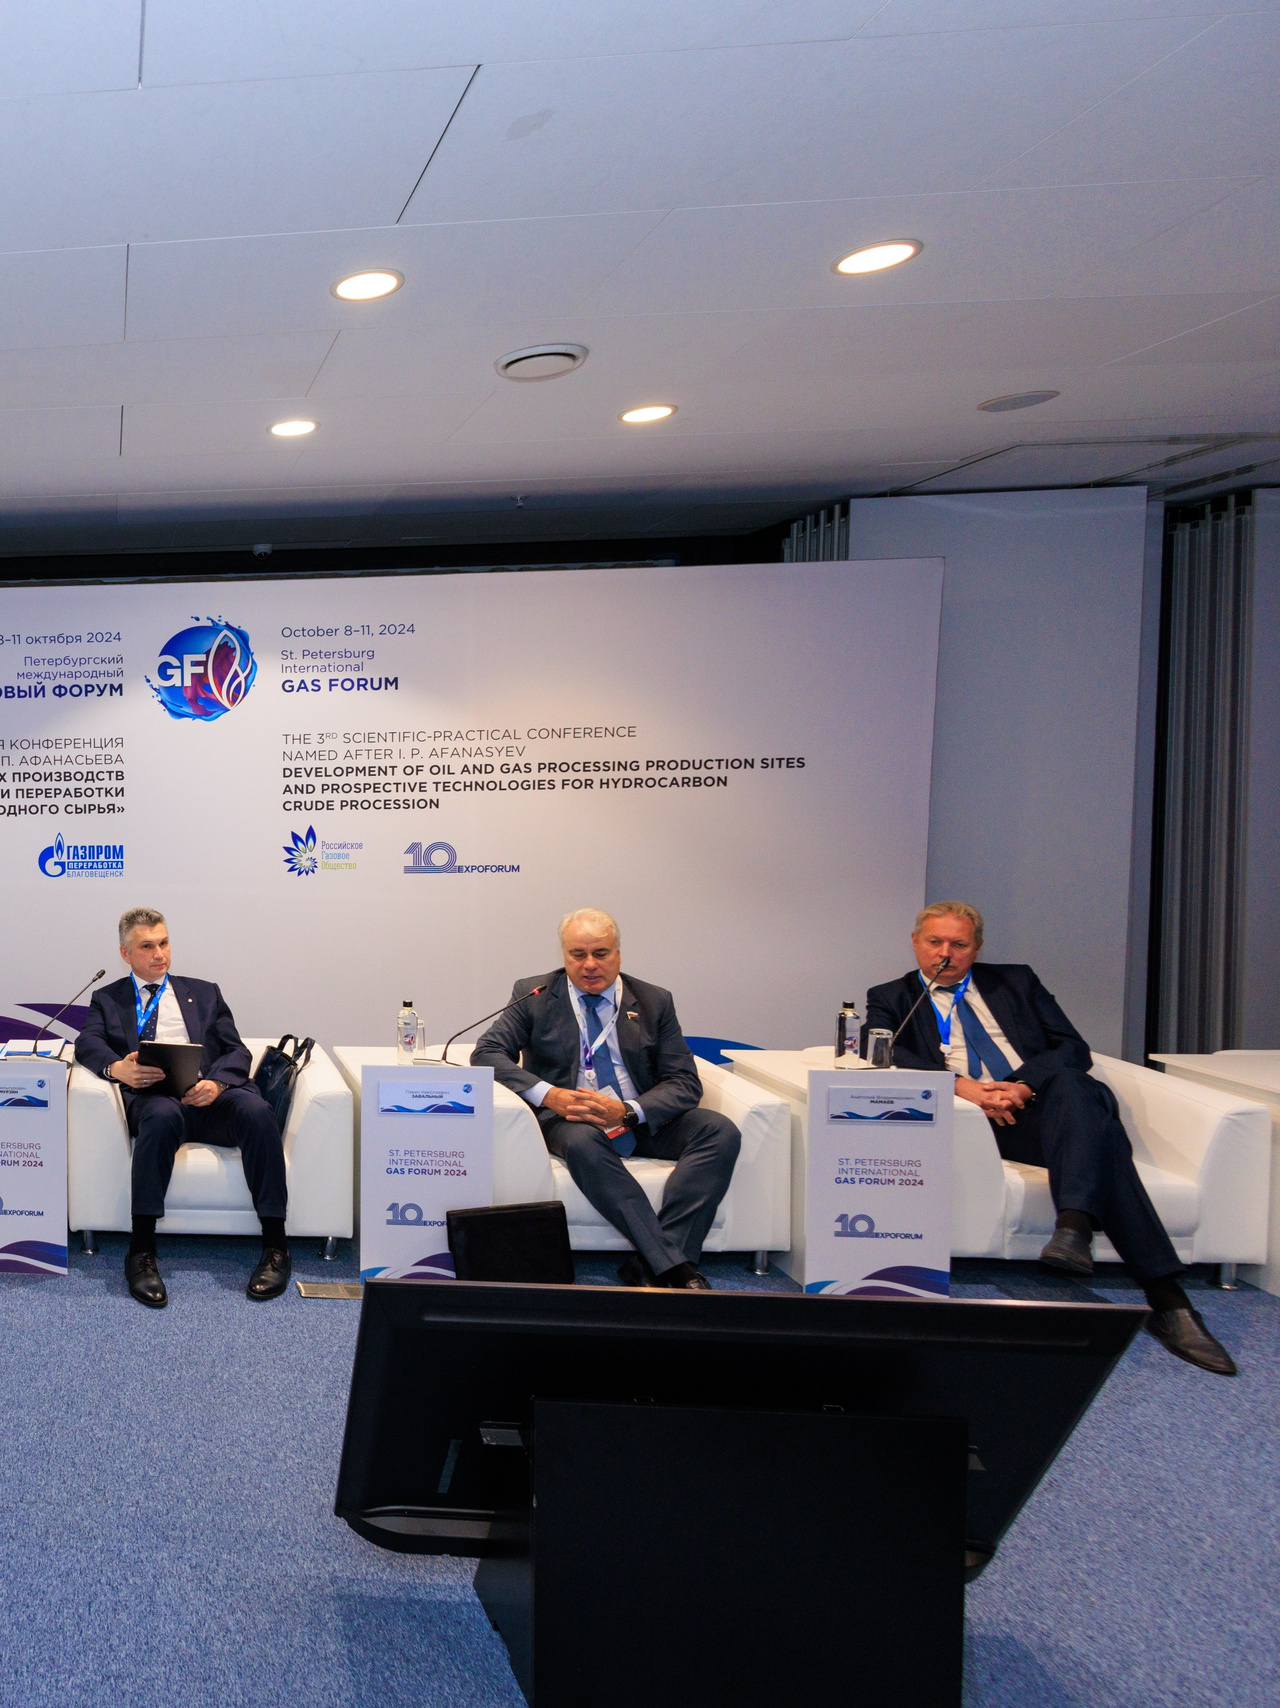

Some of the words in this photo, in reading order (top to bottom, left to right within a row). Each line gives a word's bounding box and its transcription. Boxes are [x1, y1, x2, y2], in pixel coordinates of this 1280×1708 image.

[281, 626, 340, 638] October
[379, 624, 416, 635] 2024
[25, 633, 82, 645] октября
[86, 631, 122, 643] 2024
[281, 650, 298, 660] St.
[302, 648, 375, 660] Petersburg
[24, 654, 124, 667] Петербургский
[281, 662, 364, 673] International
[16, 668, 124, 681] международный
[52, 683, 124, 698] ФОРУМ
[281, 679, 322, 693] GAS
[328, 677, 399, 692] FORUM
[282, 733, 312, 745] THE
[342, 729, 522, 744] SCIENTIFIC-PRACTICAL
[527, 726, 637, 740] CONFERENCE
[10, 737, 124, 750] КОНФЕРЕНЦИЯ
[282, 749, 338, 761] NAMED
[343, 749, 393, 760] AFTER
[398, 748, 406, 760] I.
[411, 748, 424, 760] P.
[428, 746, 526, 759] AFANASYEV
[1, 755, 14, 767] П.
[19, 754, 124, 766] АФАНАСЬЕВА
[282, 766, 398, 778] DEVELOPMENT
[403, 765, 425, 776] OF
[429, 764, 456, 776] OIL
[460, 764, 495, 775] AND
[500, 762, 532, 774] GAS
[538, 760, 640, 773] PROCESSING
[646, 758, 755, 771] PRODUCTION
[760, 757, 806, 769] SITES
[12, 770, 125, 783] ПРОИЗВОДСТВ
[282, 784, 316, 795] AND
[321, 782, 428, 794] PROSPECTIVE
[432, 779, 556, 792] TECHNOLOGIES
[561, 778, 594, 790] FOR
[600, 776, 728, 789] HYDROCARBON
[15, 787, 125, 799] ПЕРЕРАБОТКИ
[64, 803, 125, 815] СЫРЬЯ»
[282, 800, 335, 812] CRUDE
[340, 798, 440, 810] PROCESSION
[321, 840, 364, 850] Российское
[67, 845, 124, 860] ГАЗПРОМ
[321, 851, 350, 860] Газовое
[68, 861, 123, 870] ПЕРЕРАБОТКА
[321, 860, 357, 870] Общество
[457, 864, 520, 874] EXPOFORUM
[67, 870, 124, 878] БЛАГОВЕЩЕНСК
[404, 1150, 465, 1158] PETERSBURG
[22, 1160, 44, 1168] 2024
[389, 1158, 464, 1168] INTERNATIONAL
[838, 1158, 852, 1166] ST.
[854, 1158, 922, 1168] PETERSBURG
[408, 1168, 441, 1176] FORUM
[444, 1169, 467, 1177] 2024
[838, 1167, 920, 1177] INTERNATIONAL
[835, 1177, 856, 1185] GAS
[859, 1178, 896, 1186] FORUM
[898, 1178, 924, 1186] 2024
[875, 1232, 923, 1240] EXPOFORUM
